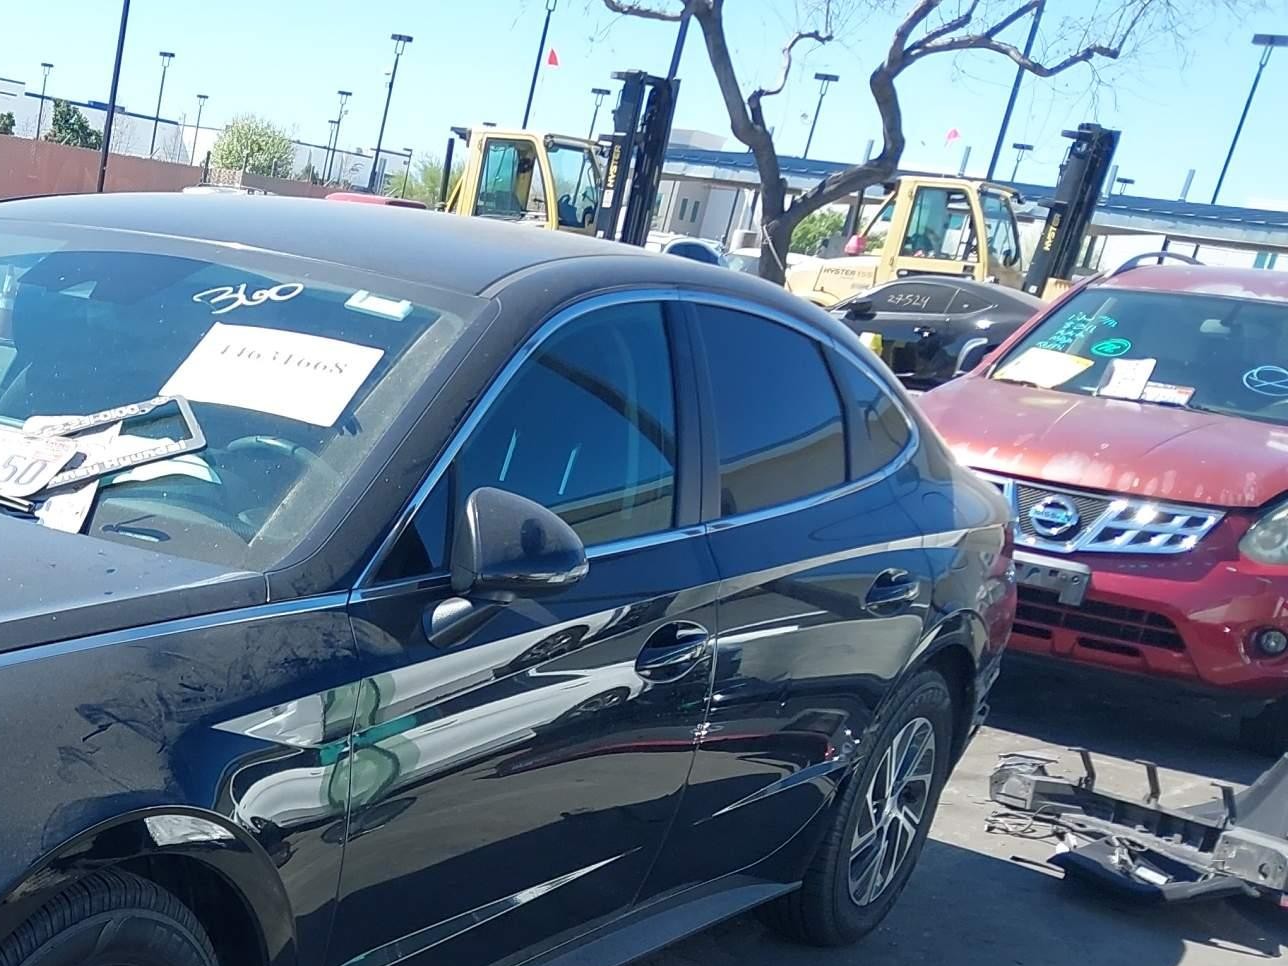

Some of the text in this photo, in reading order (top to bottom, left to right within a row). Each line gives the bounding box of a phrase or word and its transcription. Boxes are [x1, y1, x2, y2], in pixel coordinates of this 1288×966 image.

[607, 144, 621, 187] HYSTER
[823, 267, 856, 276] HYSTER
[192, 282, 305, 315] 360
[887, 294, 932, 309] 27524
